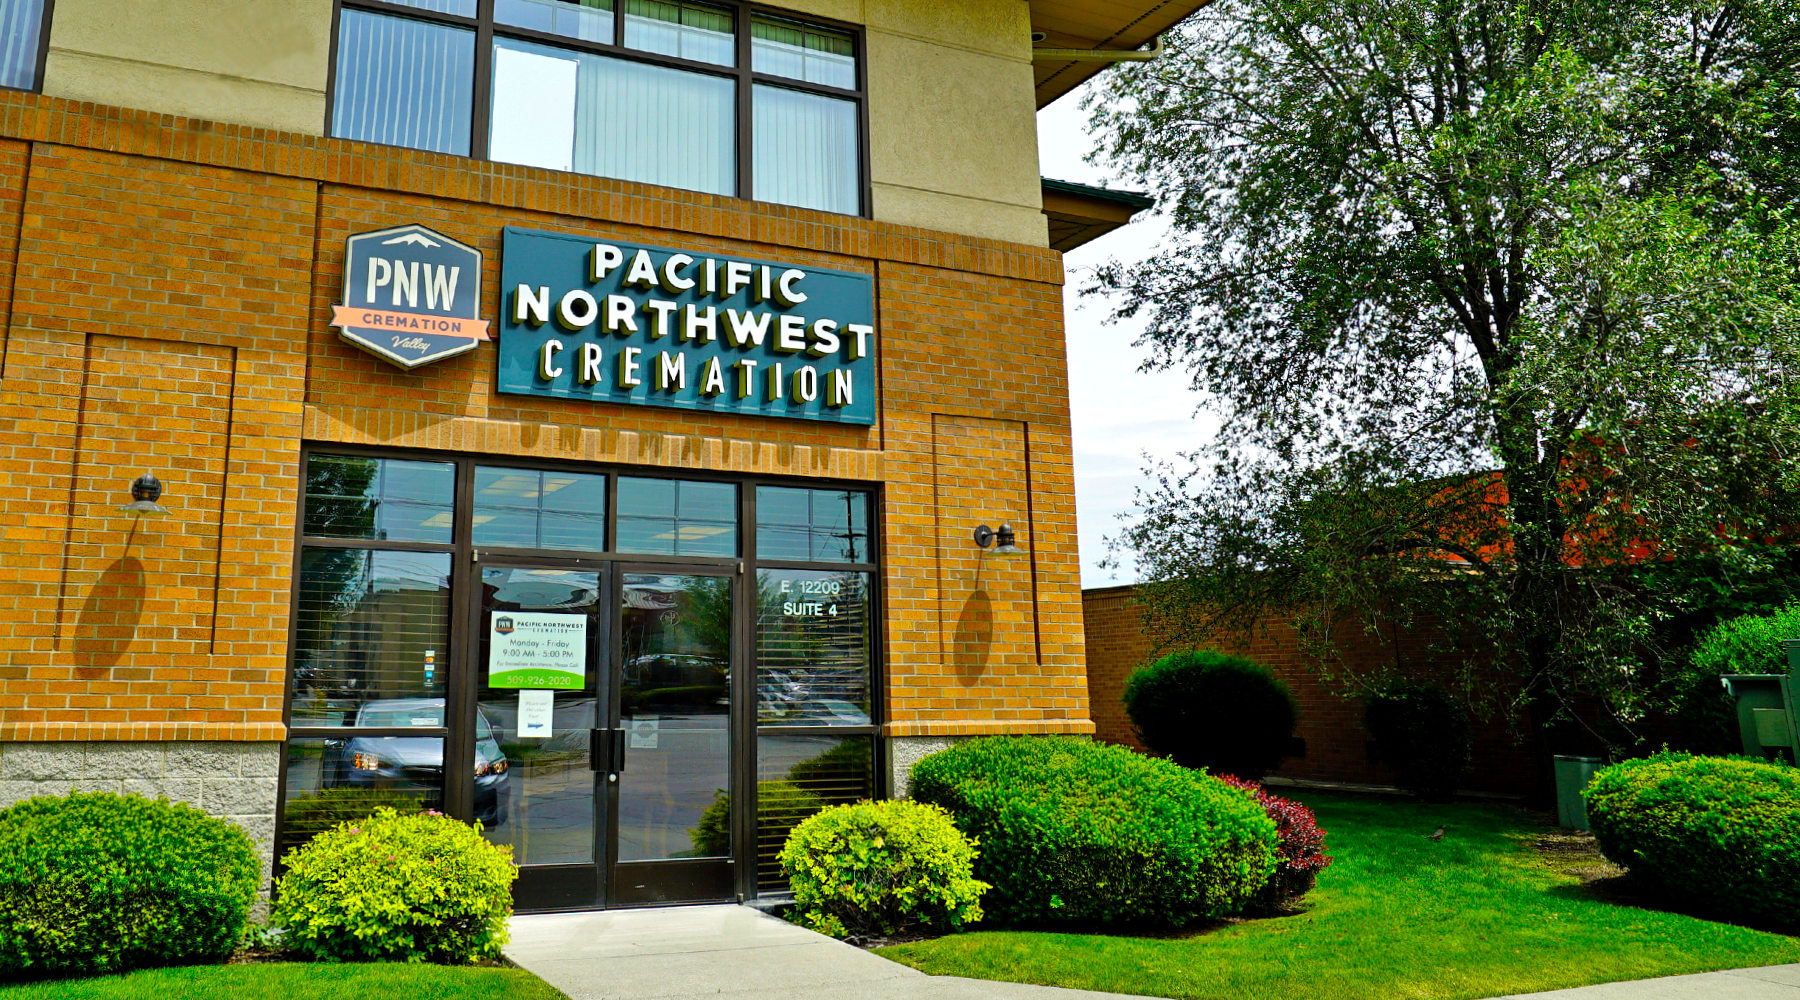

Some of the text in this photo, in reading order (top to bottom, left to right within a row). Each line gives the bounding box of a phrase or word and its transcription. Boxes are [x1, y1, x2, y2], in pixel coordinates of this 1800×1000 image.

[594, 243, 808, 305] PACIFIC
[366, 257, 460, 311] PNW
[362, 313, 462, 333] CREMATION
[515, 283, 873, 358] NORTHWEST
[391, 335, 431, 354] Valley
[543, 339, 853, 405] CREMATION
[781, 580, 840, 595] E. 12209
[783, 601, 838, 617] SUITE 4
[502, 649, 520, 657] 9:00
[542, 650, 560, 658] 5:00
[509, 639, 540, 648] Monday
[547, 640, 570, 649] Friday
[507, 675, 571, 686] 509-926-2020
